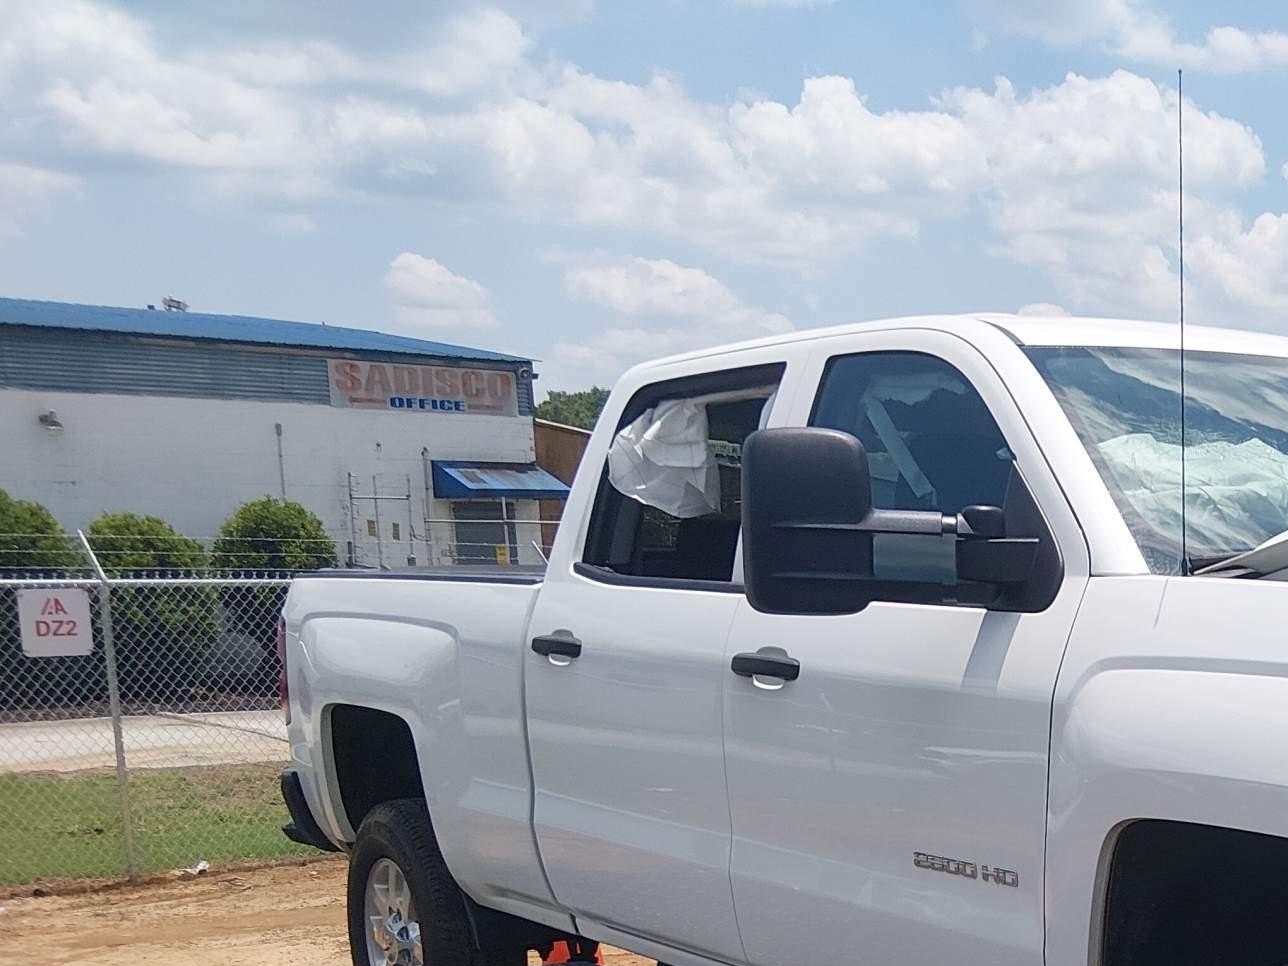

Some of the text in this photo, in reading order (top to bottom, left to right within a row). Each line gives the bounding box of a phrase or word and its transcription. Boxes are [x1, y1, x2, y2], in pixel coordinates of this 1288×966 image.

[335, 362, 511, 399] SADISCO
[390, 397, 465, 412] OFFICE
[35, 620, 78, 637] DZ2
